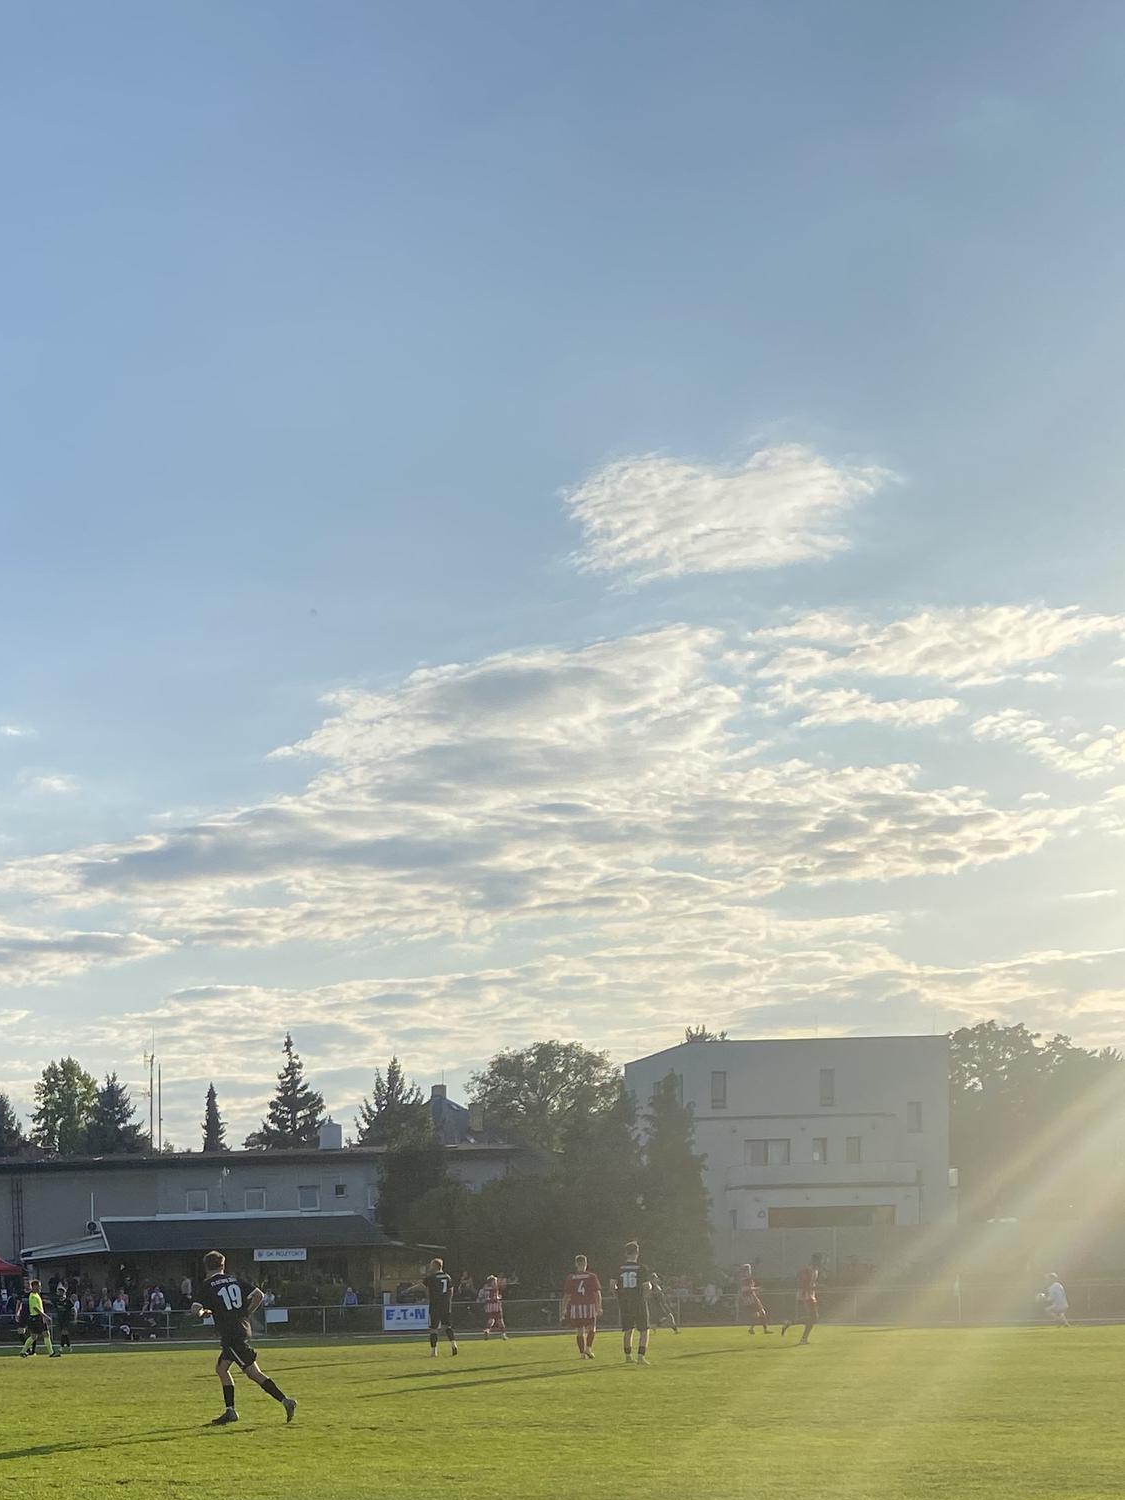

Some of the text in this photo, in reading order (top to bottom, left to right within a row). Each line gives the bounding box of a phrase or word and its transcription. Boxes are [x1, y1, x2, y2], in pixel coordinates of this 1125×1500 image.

[577, 1279, 586, 1296] 4
[620, 1271, 637, 1289] 16
[217, 1284, 243, 1311] 19
